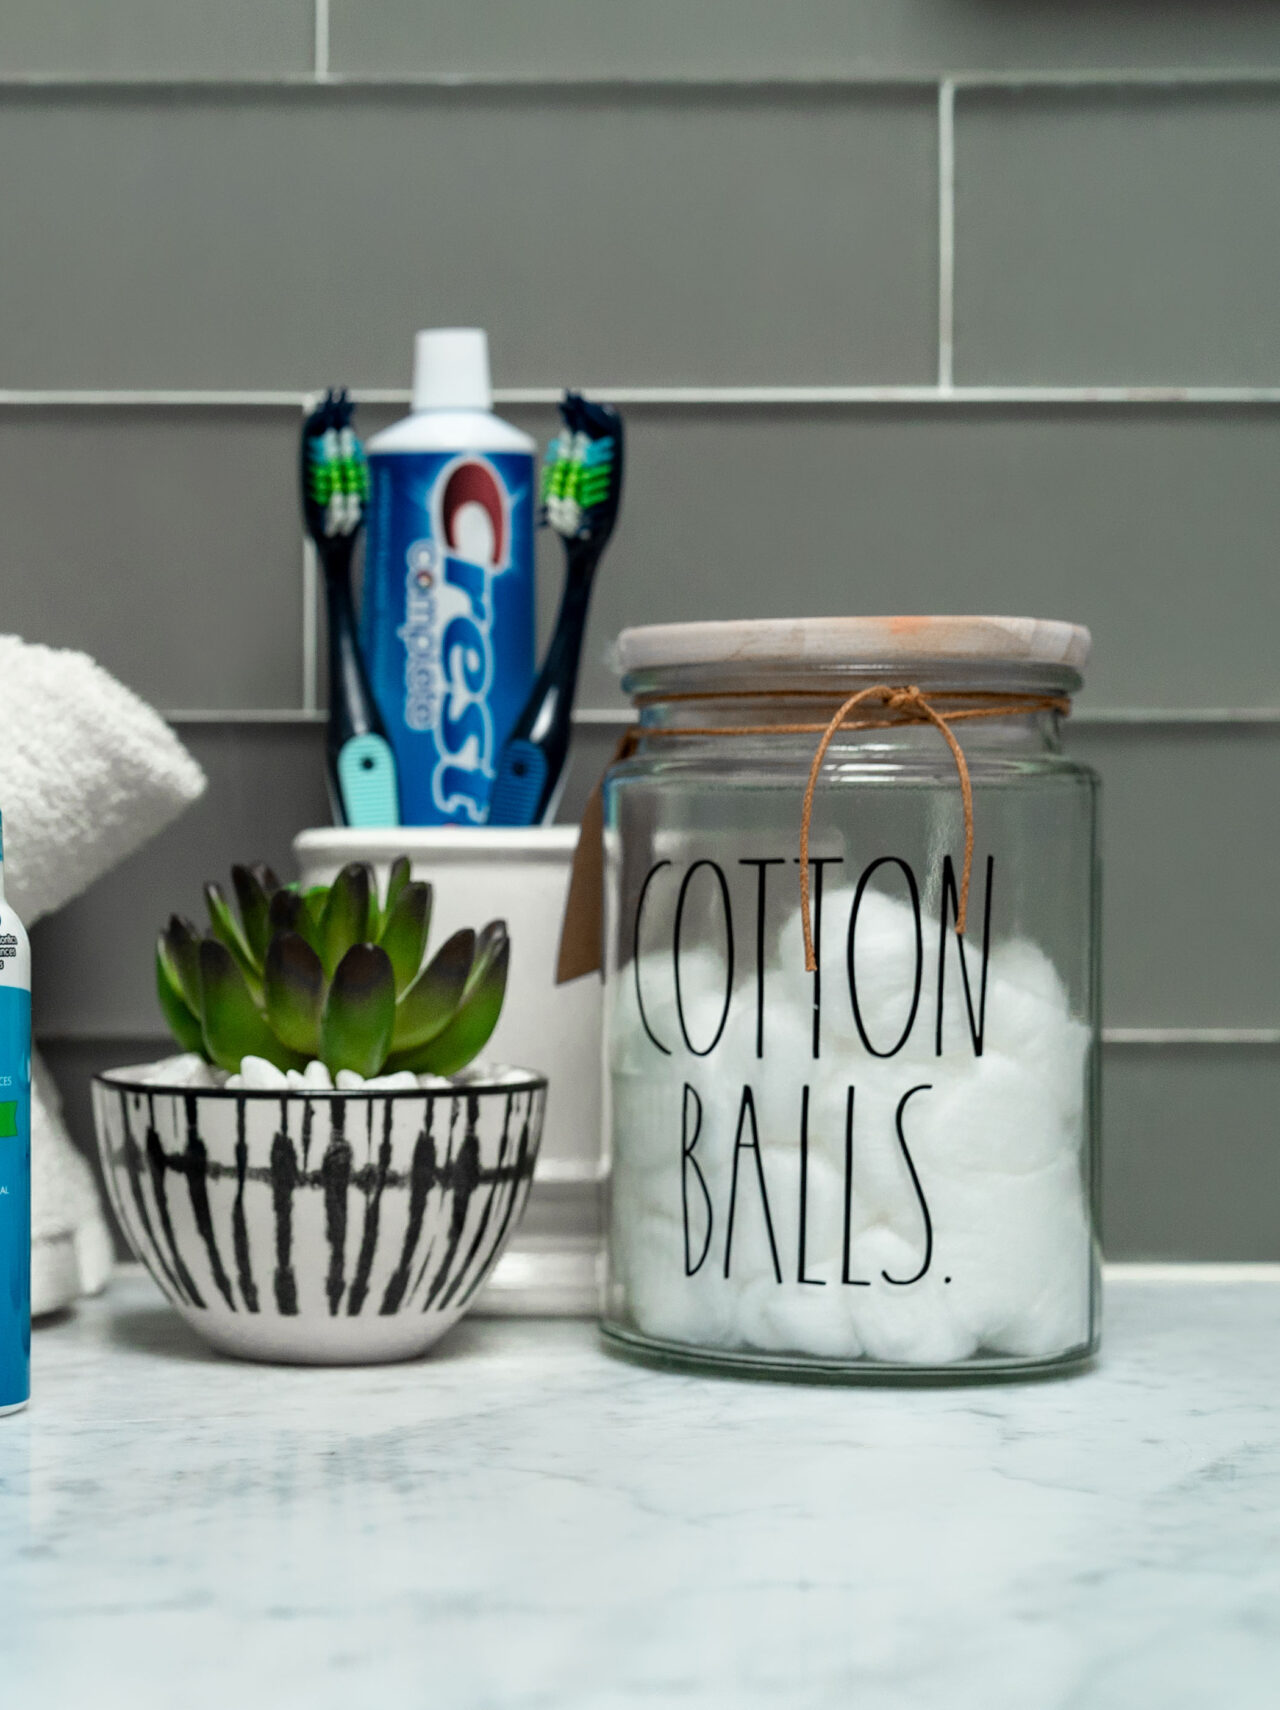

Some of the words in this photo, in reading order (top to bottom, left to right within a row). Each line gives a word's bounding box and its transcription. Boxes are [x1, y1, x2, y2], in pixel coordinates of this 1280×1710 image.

[434, 455, 511, 824] Crest
[634, 855, 994, 1060] COTTON
[682, 1082, 952, 1286] BALLS.
